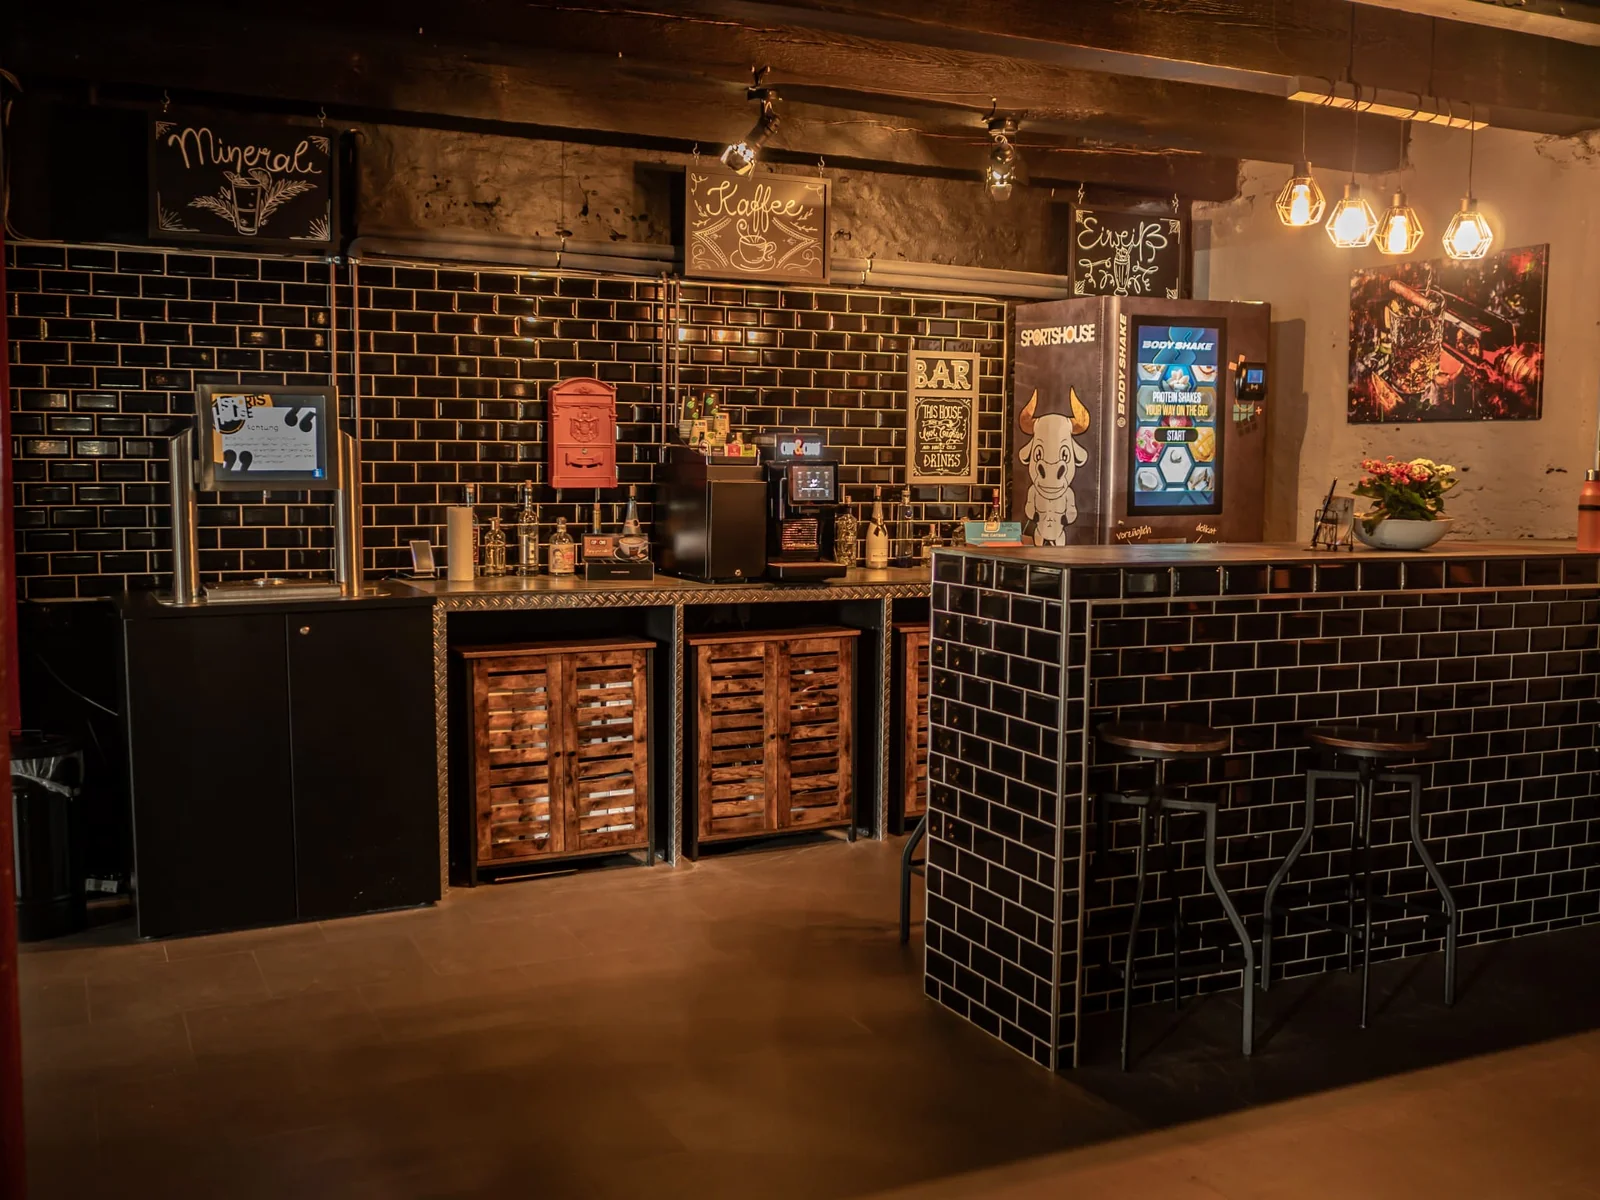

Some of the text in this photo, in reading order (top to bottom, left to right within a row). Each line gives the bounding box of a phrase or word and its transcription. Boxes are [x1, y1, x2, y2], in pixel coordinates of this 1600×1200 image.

[168, 127, 321, 174] Mineral
[706, 180, 803, 233] Kaffee
[1020, 323, 1096, 347] SPORTSHOUSE
[915, 359, 972, 390] BAR
[1152, 391, 1202, 404] PROTEIN SHAKES
[921, 404, 963, 419] THIS HOUSE
[1145, 404, 1162, 415] YOUR
[1162, 404, 1176, 415] WAY
[1176, 404, 1185, 415] ON
[1186, 404, 1197, 415] THE
[1166, 430, 1187, 441] START
[923, 453, 961, 467] DRINKS
[1115, 525, 1152, 540] vorzüglich
